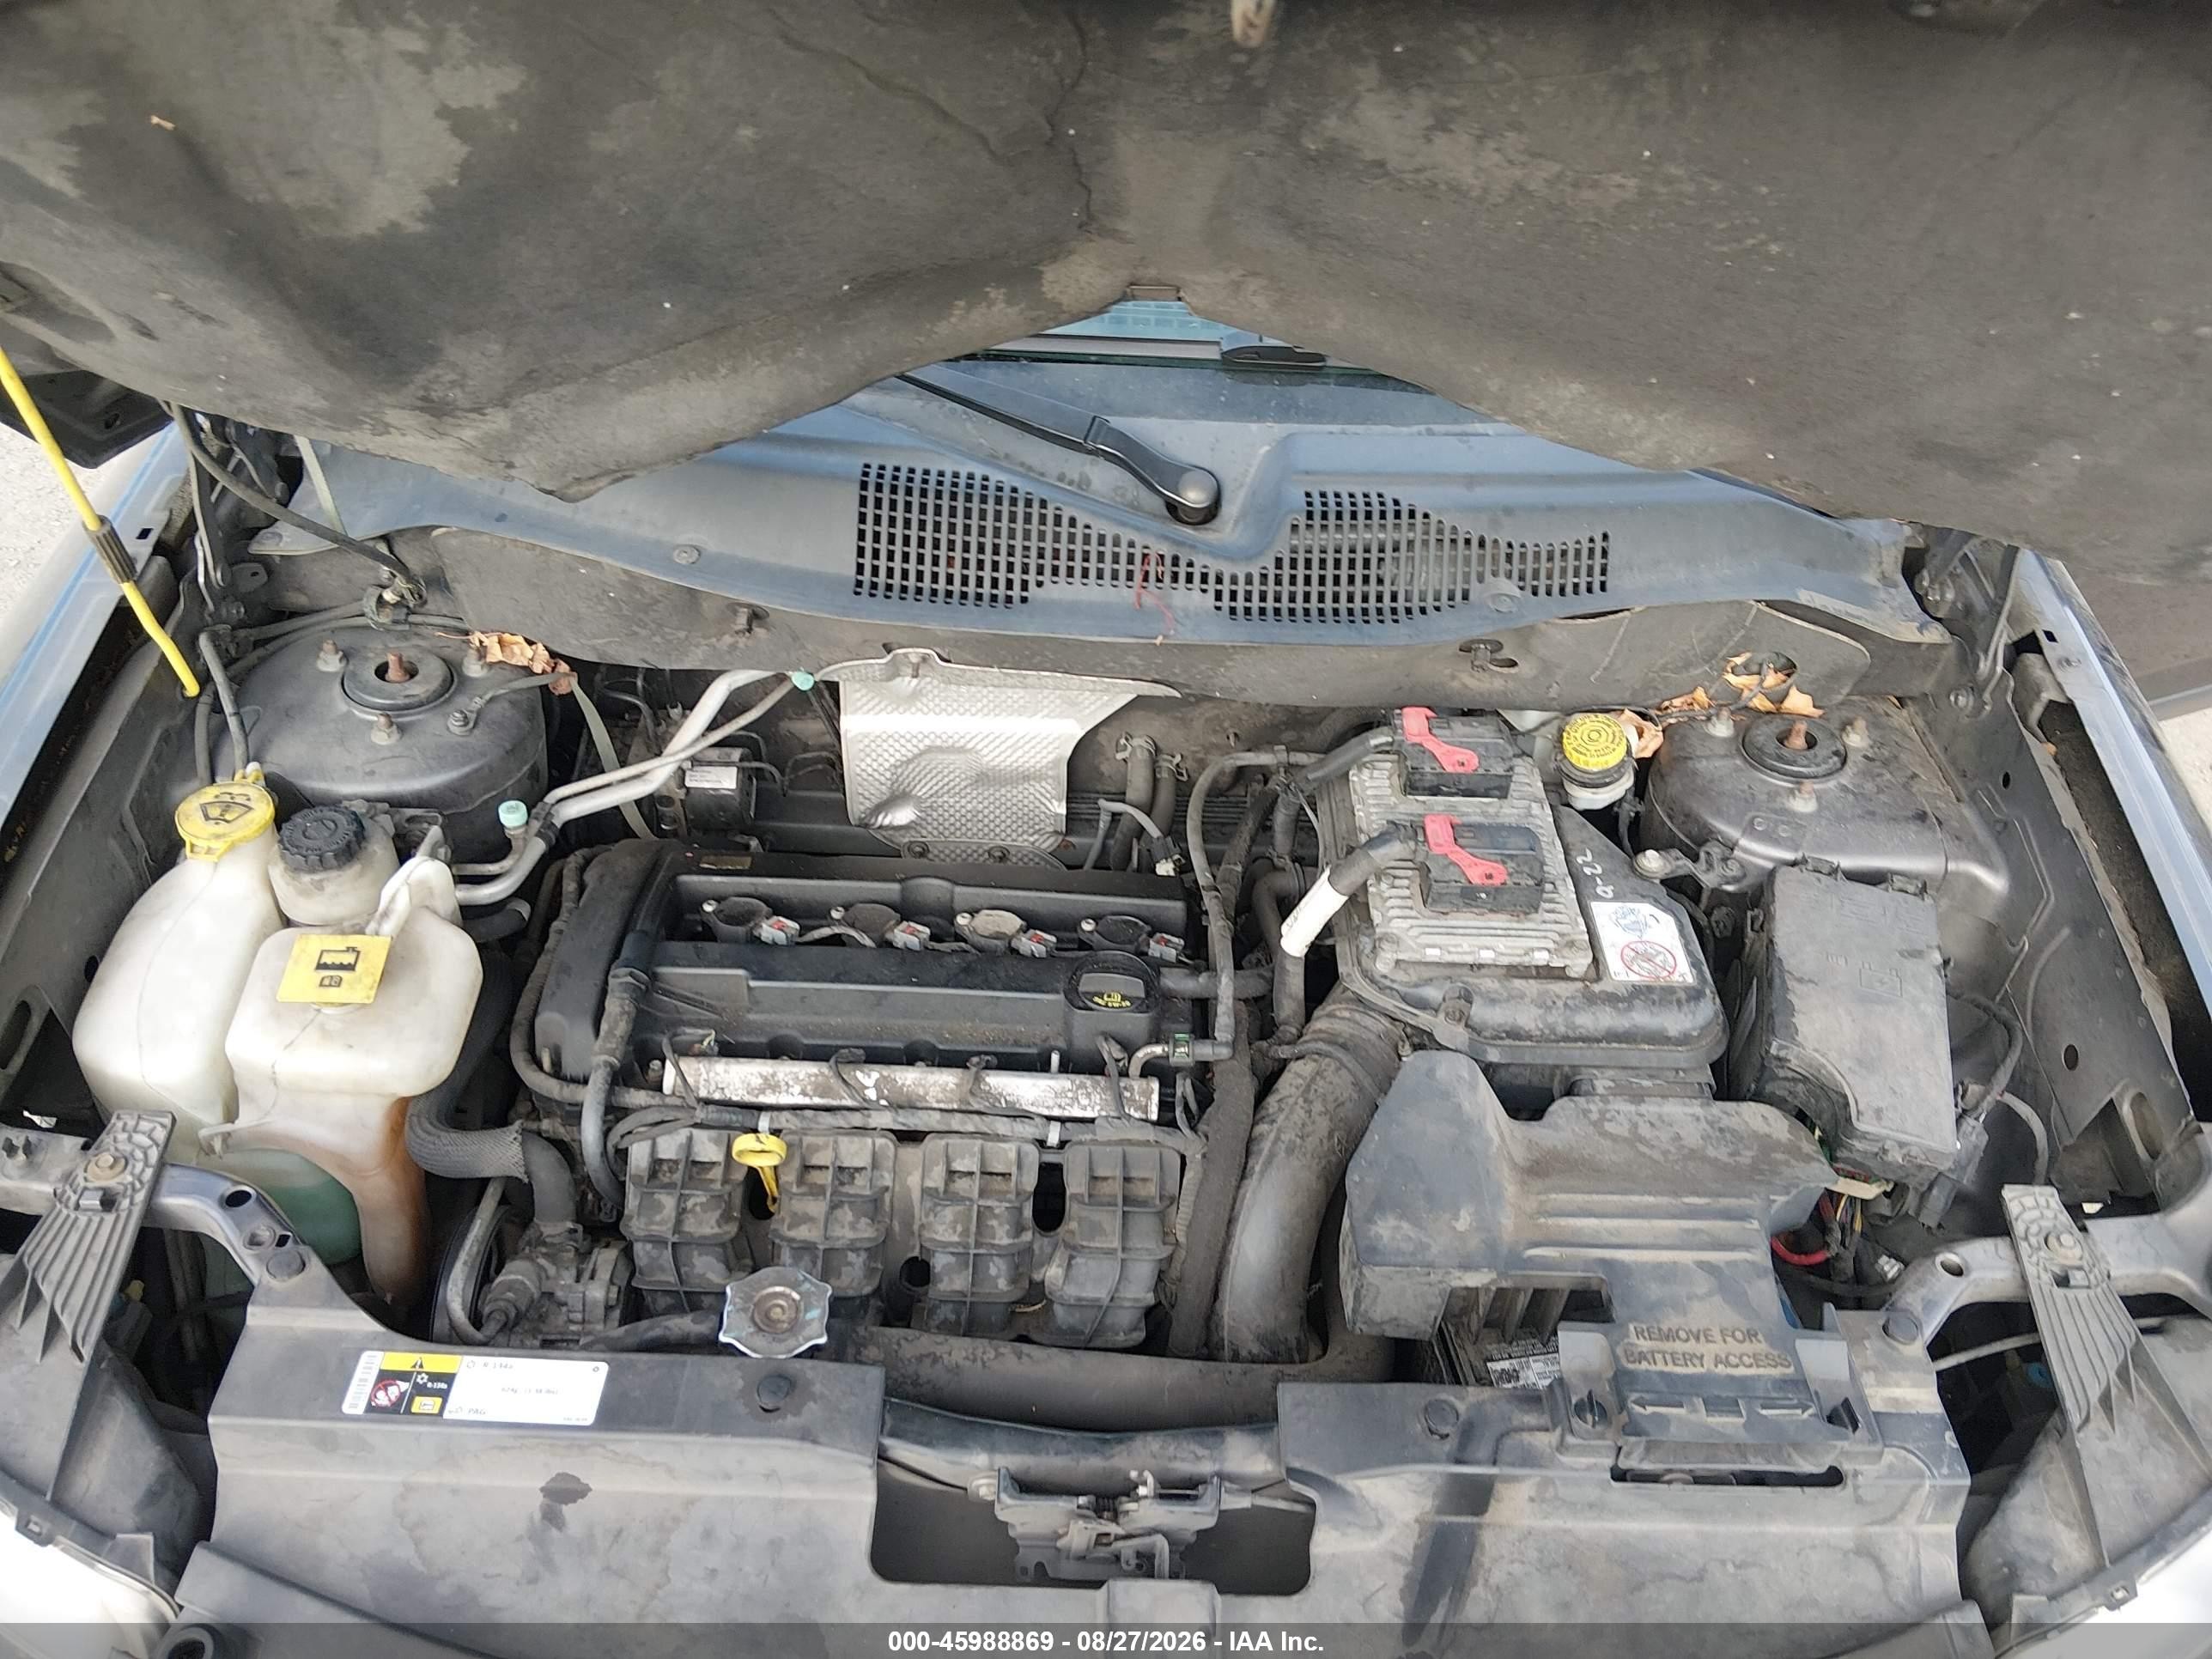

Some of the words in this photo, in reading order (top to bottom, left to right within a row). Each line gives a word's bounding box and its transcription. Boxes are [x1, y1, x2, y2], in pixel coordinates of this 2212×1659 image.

[1633, 1325, 1717, 1345] REMOVE
[1720, 1328, 1763, 1345] FOR
[1623, 1346, 1705, 1369] BATTERY
[1714, 1352, 1793, 1370] ACCESS
